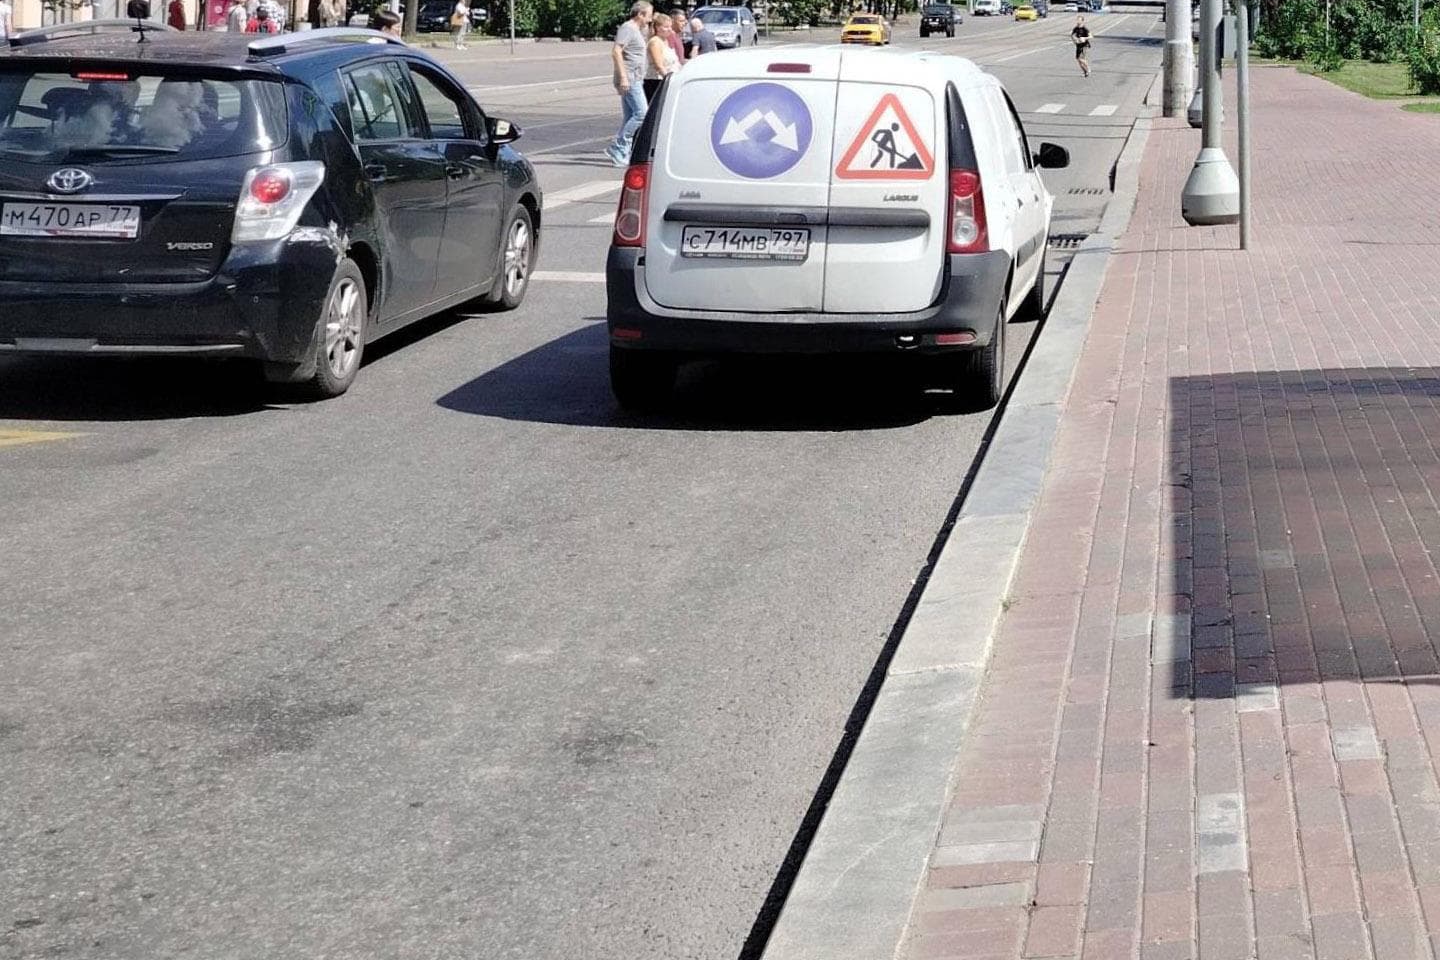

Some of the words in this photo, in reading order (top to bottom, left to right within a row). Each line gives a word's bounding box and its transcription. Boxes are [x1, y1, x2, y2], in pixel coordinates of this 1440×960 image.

[883, 194, 919, 202] LARGUS
[110, 206, 132, 222] 77
[166, 241, 214, 250] VERSO
[773, 231, 801, 248] 797
